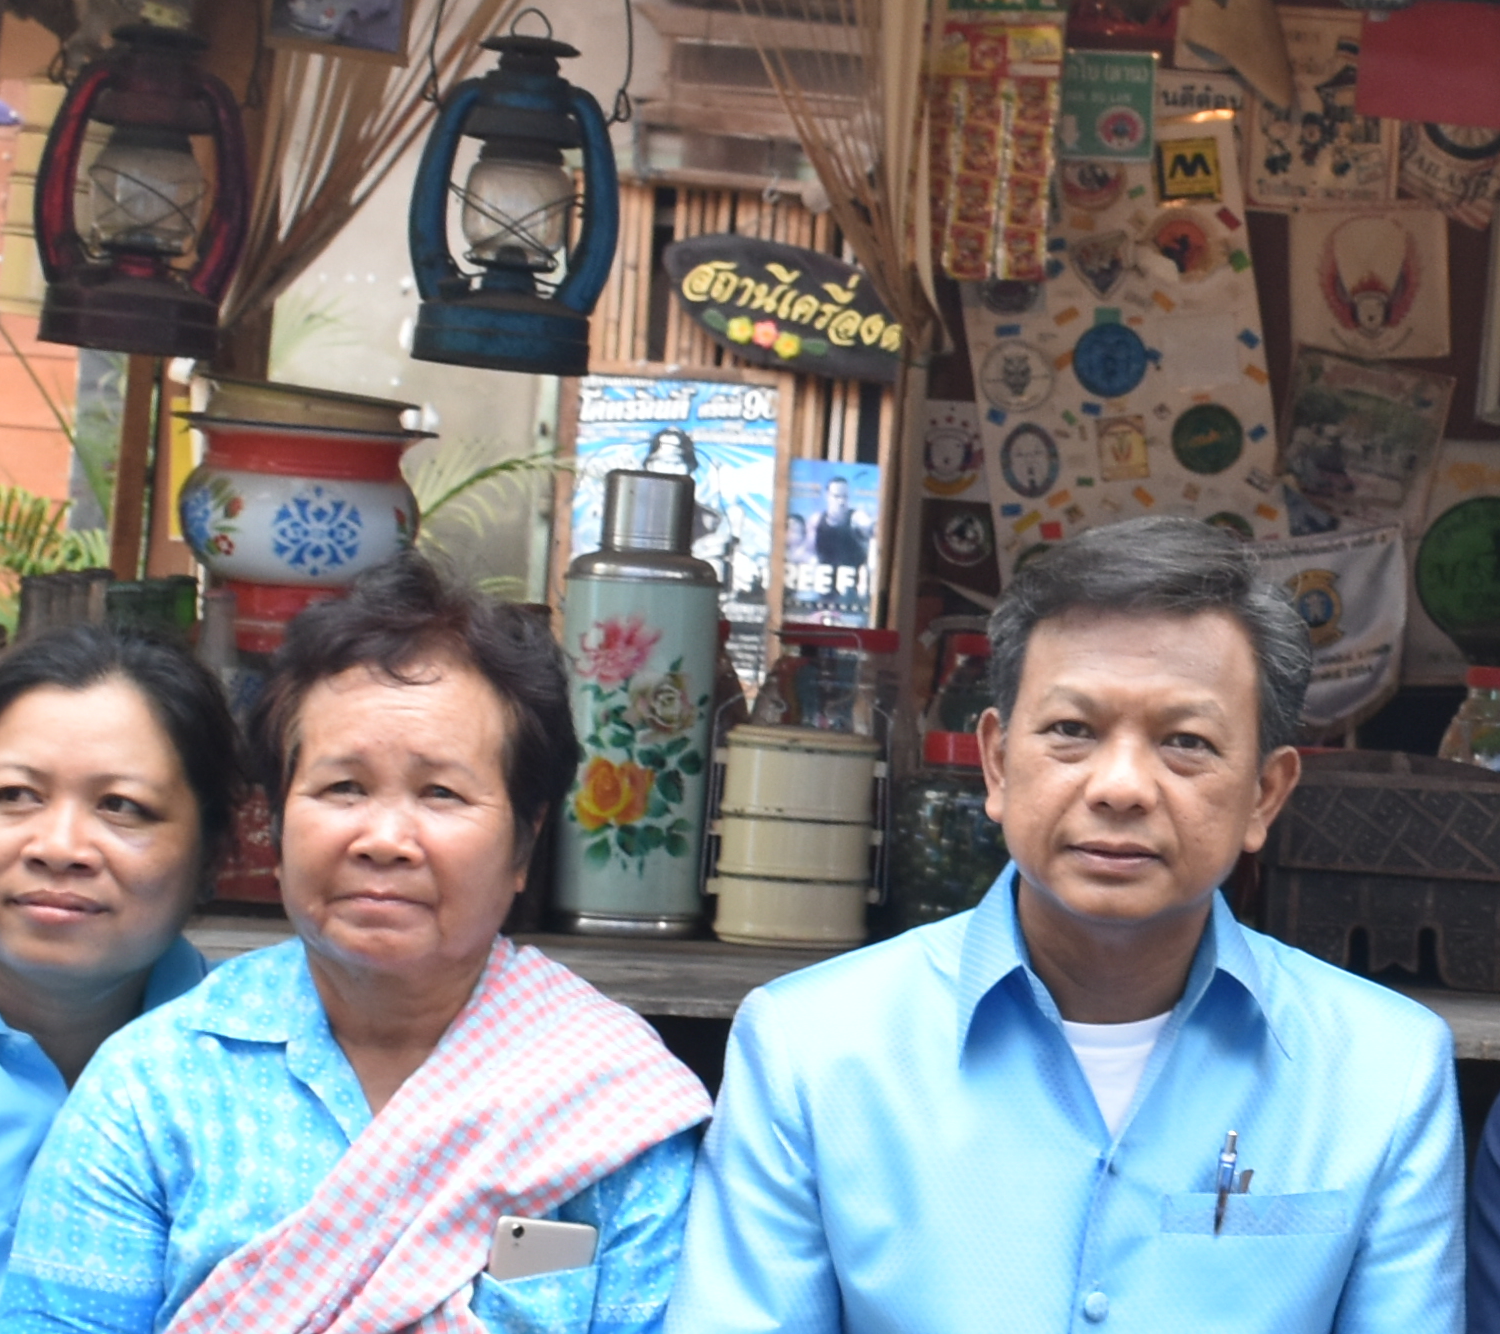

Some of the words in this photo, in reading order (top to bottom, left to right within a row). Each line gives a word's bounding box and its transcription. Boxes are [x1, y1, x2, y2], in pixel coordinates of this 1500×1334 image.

[681, 260, 902, 353] สถานีเครื่องด
